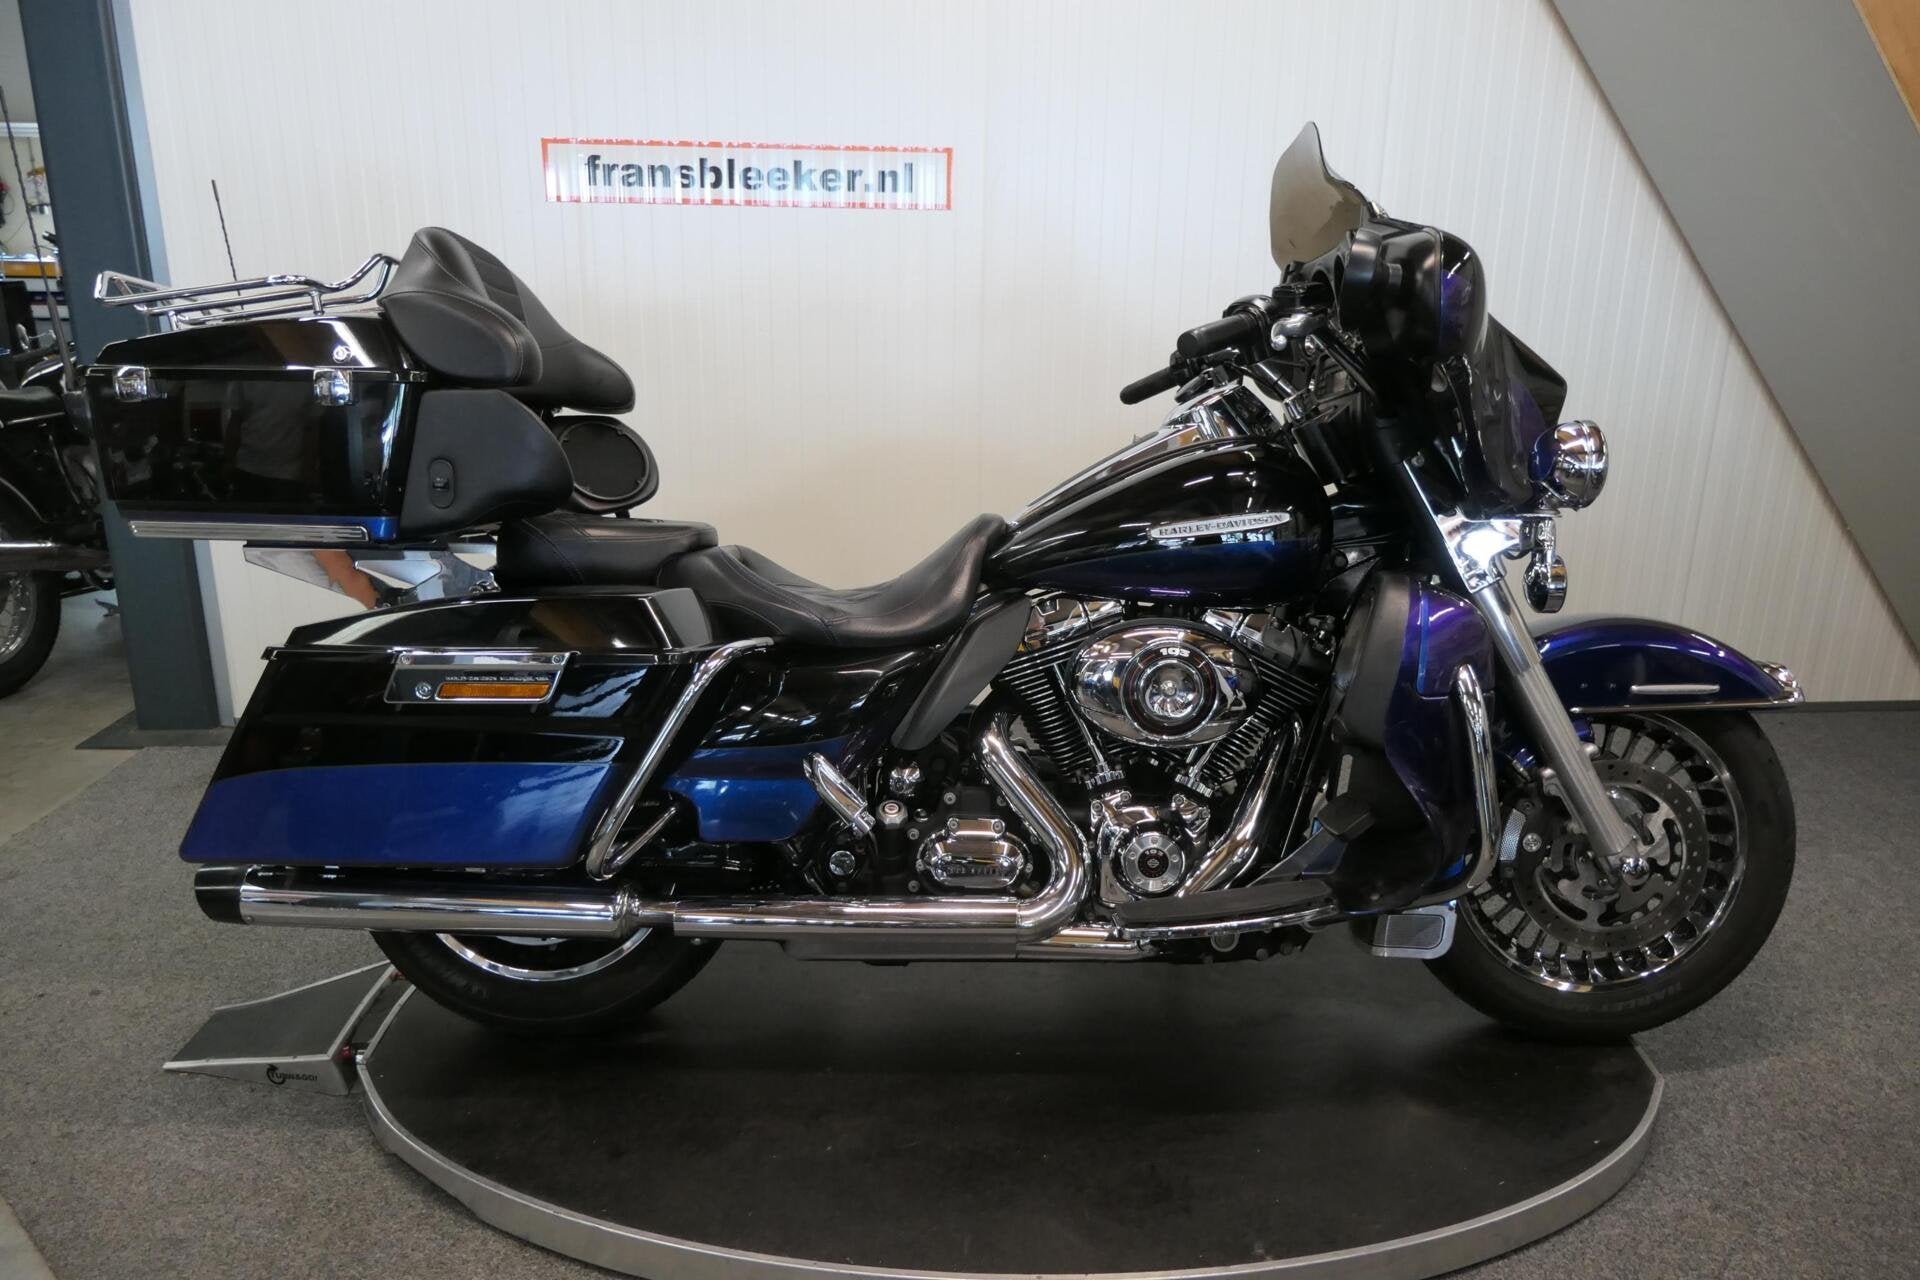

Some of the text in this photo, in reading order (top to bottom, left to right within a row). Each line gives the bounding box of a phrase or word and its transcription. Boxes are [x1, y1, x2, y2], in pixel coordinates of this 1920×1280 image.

[585, 154, 914, 194] fransbleeker.nl
[1158, 514, 1283, 536] HARLEY-DAVIDSON
[1160, 647, 1190, 657] 103
